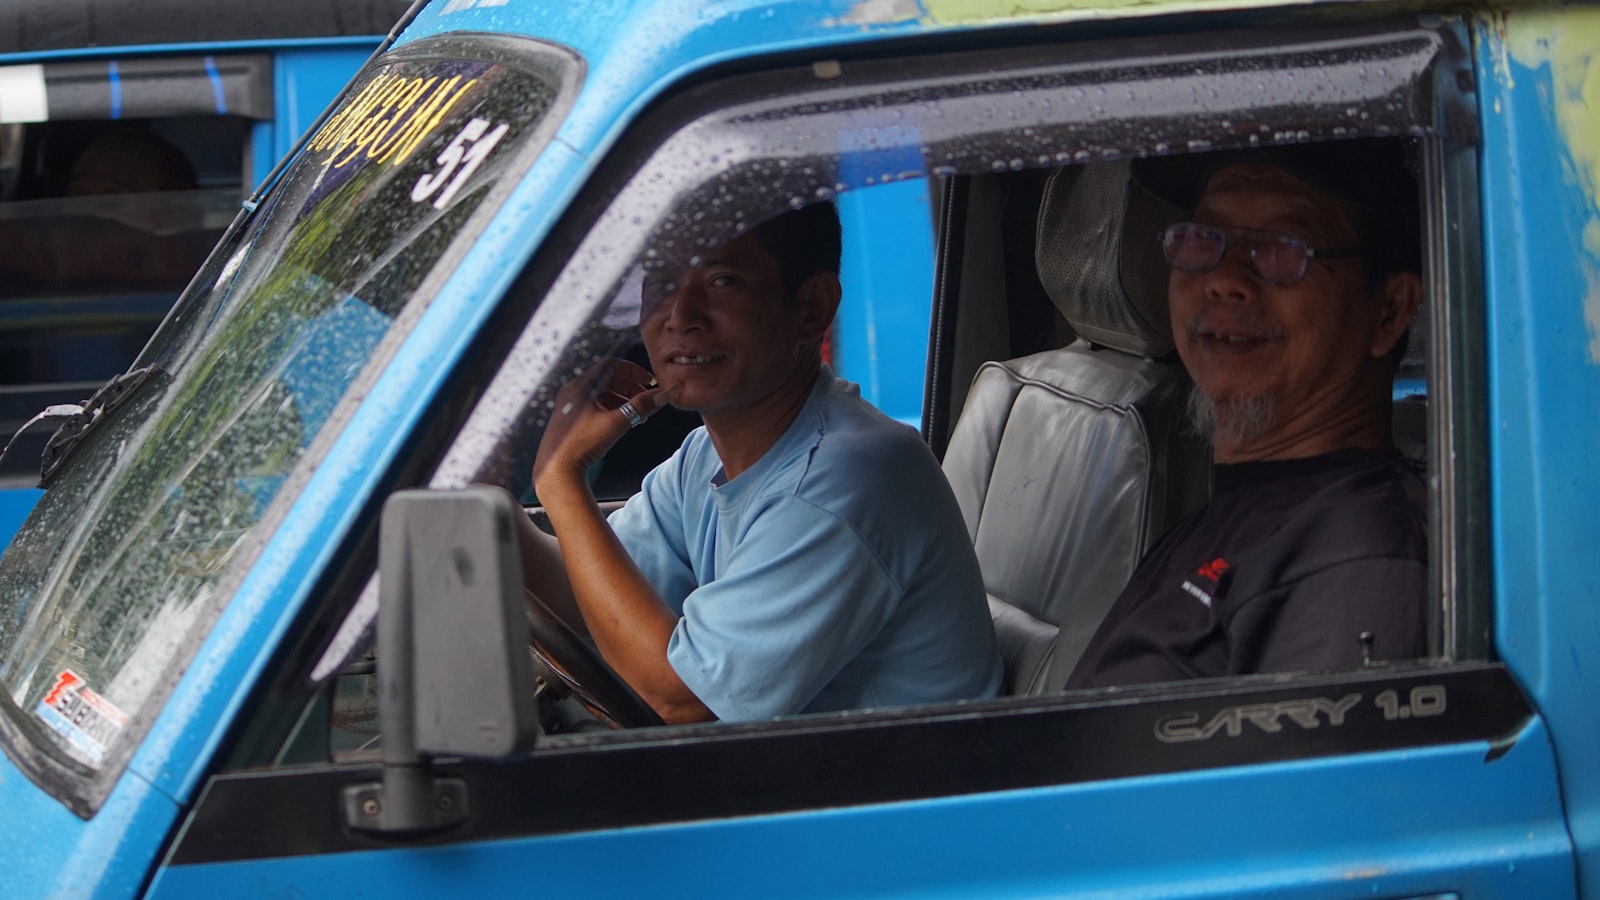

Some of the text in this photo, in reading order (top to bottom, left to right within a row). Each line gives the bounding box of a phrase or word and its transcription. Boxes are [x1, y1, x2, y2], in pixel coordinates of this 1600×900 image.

[410, 117, 511, 210] 51
[1153, 684, 1447, 743] CARRY 1.0
